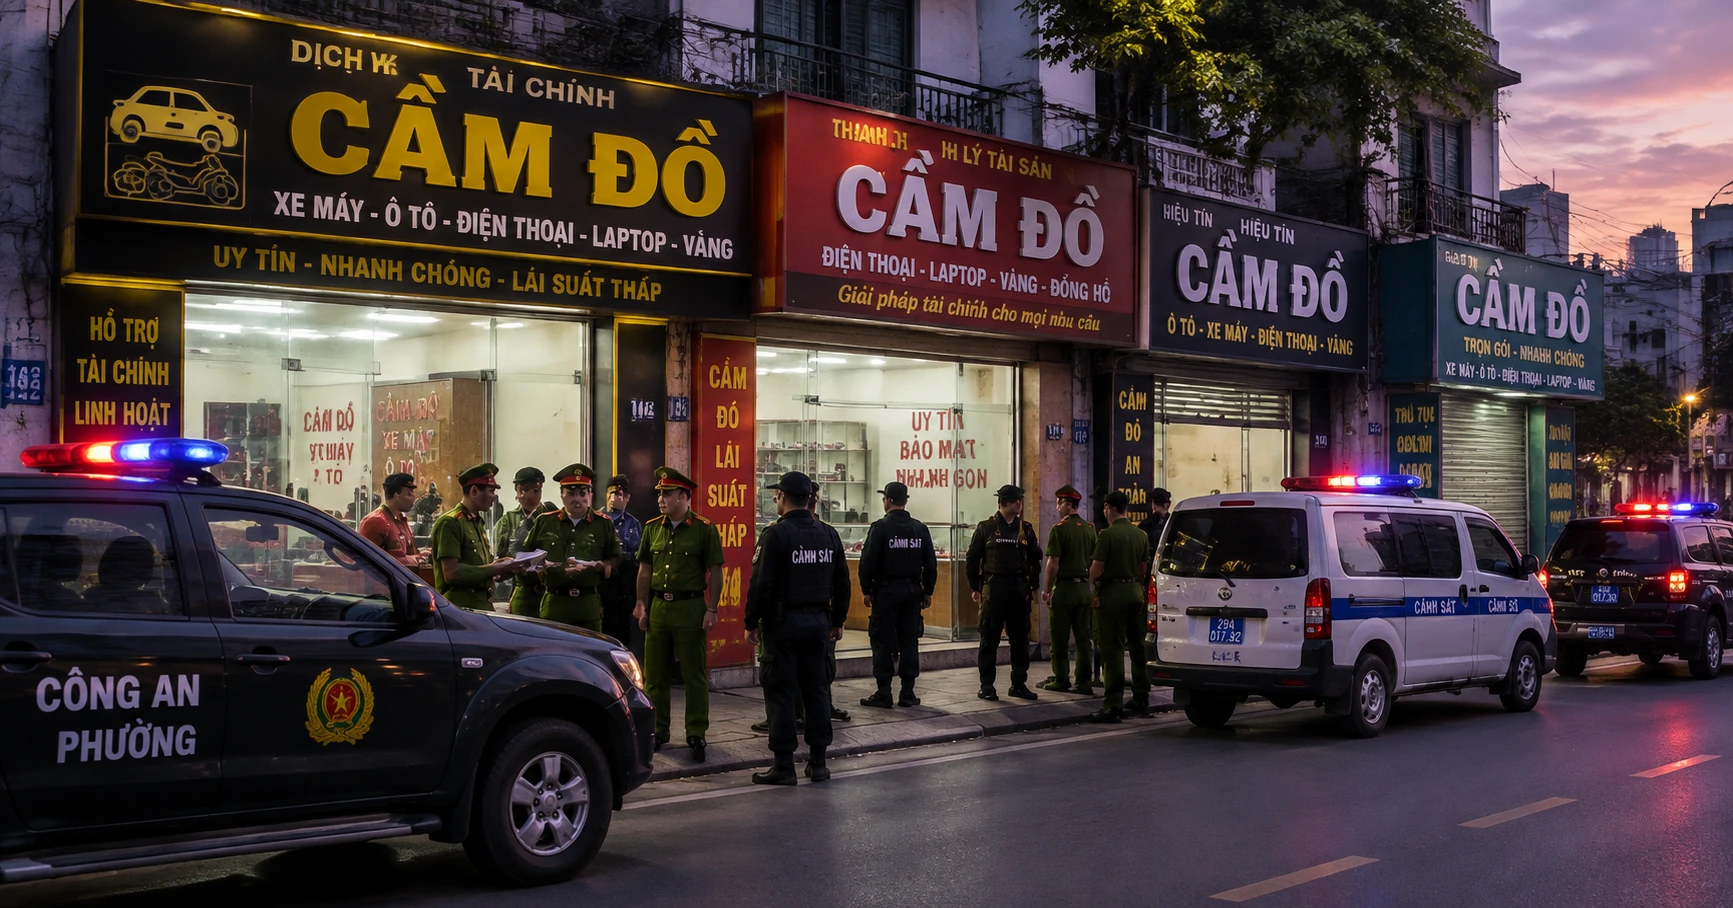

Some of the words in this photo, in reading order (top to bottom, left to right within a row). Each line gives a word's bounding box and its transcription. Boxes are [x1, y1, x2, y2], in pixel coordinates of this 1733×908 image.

[290, 73, 552, 198] CẦM
[587, 119, 726, 217] ĐỒ
[274, 191, 304, 217] XE
[313, 192, 364, 223] MÁY
[385, 197, 400, 227] Ô
[408, 201, 436, 230] TÔ
[456, 207, 506, 242] ĐIỆN
[513, 216, 574, 249] THOẠI
[593, 225, 666, 253] LAPTOP
[836, 150, 997, 251] CẦM
[1017, 185, 1104, 267] ĐỒ
[214, 245, 248, 269] UY
[255, 244, 296, 273] TÍN
[320, 254, 402, 281] NHANH
[822, 244, 862, 274] ĐIỆN
[867, 252, 915, 282] THOẠI
[930, 261, 986, 287] LAPTOP
[1176, 228, 1278, 313] CẦM
[1289, 250, 1348, 323] ĐỒ
[876, 289, 919, 313] pháp
[991, 304, 1017, 323] cho
[1021, 310, 1046, 330] mọi
[1457, 258, 1536, 335] CẦM
[1545, 279, 1591, 344] ĐỒ
[1207, 321, 1221, 340] XE
[75, 400, 116, 425] LINH
[911, 411, 932, 432] UY
[1125, 456, 1141, 475] AN
[36, 666, 140, 713] CÔNG
[151, 674, 200, 708] AN
[57, 718, 197, 764] PHƯỜNG
